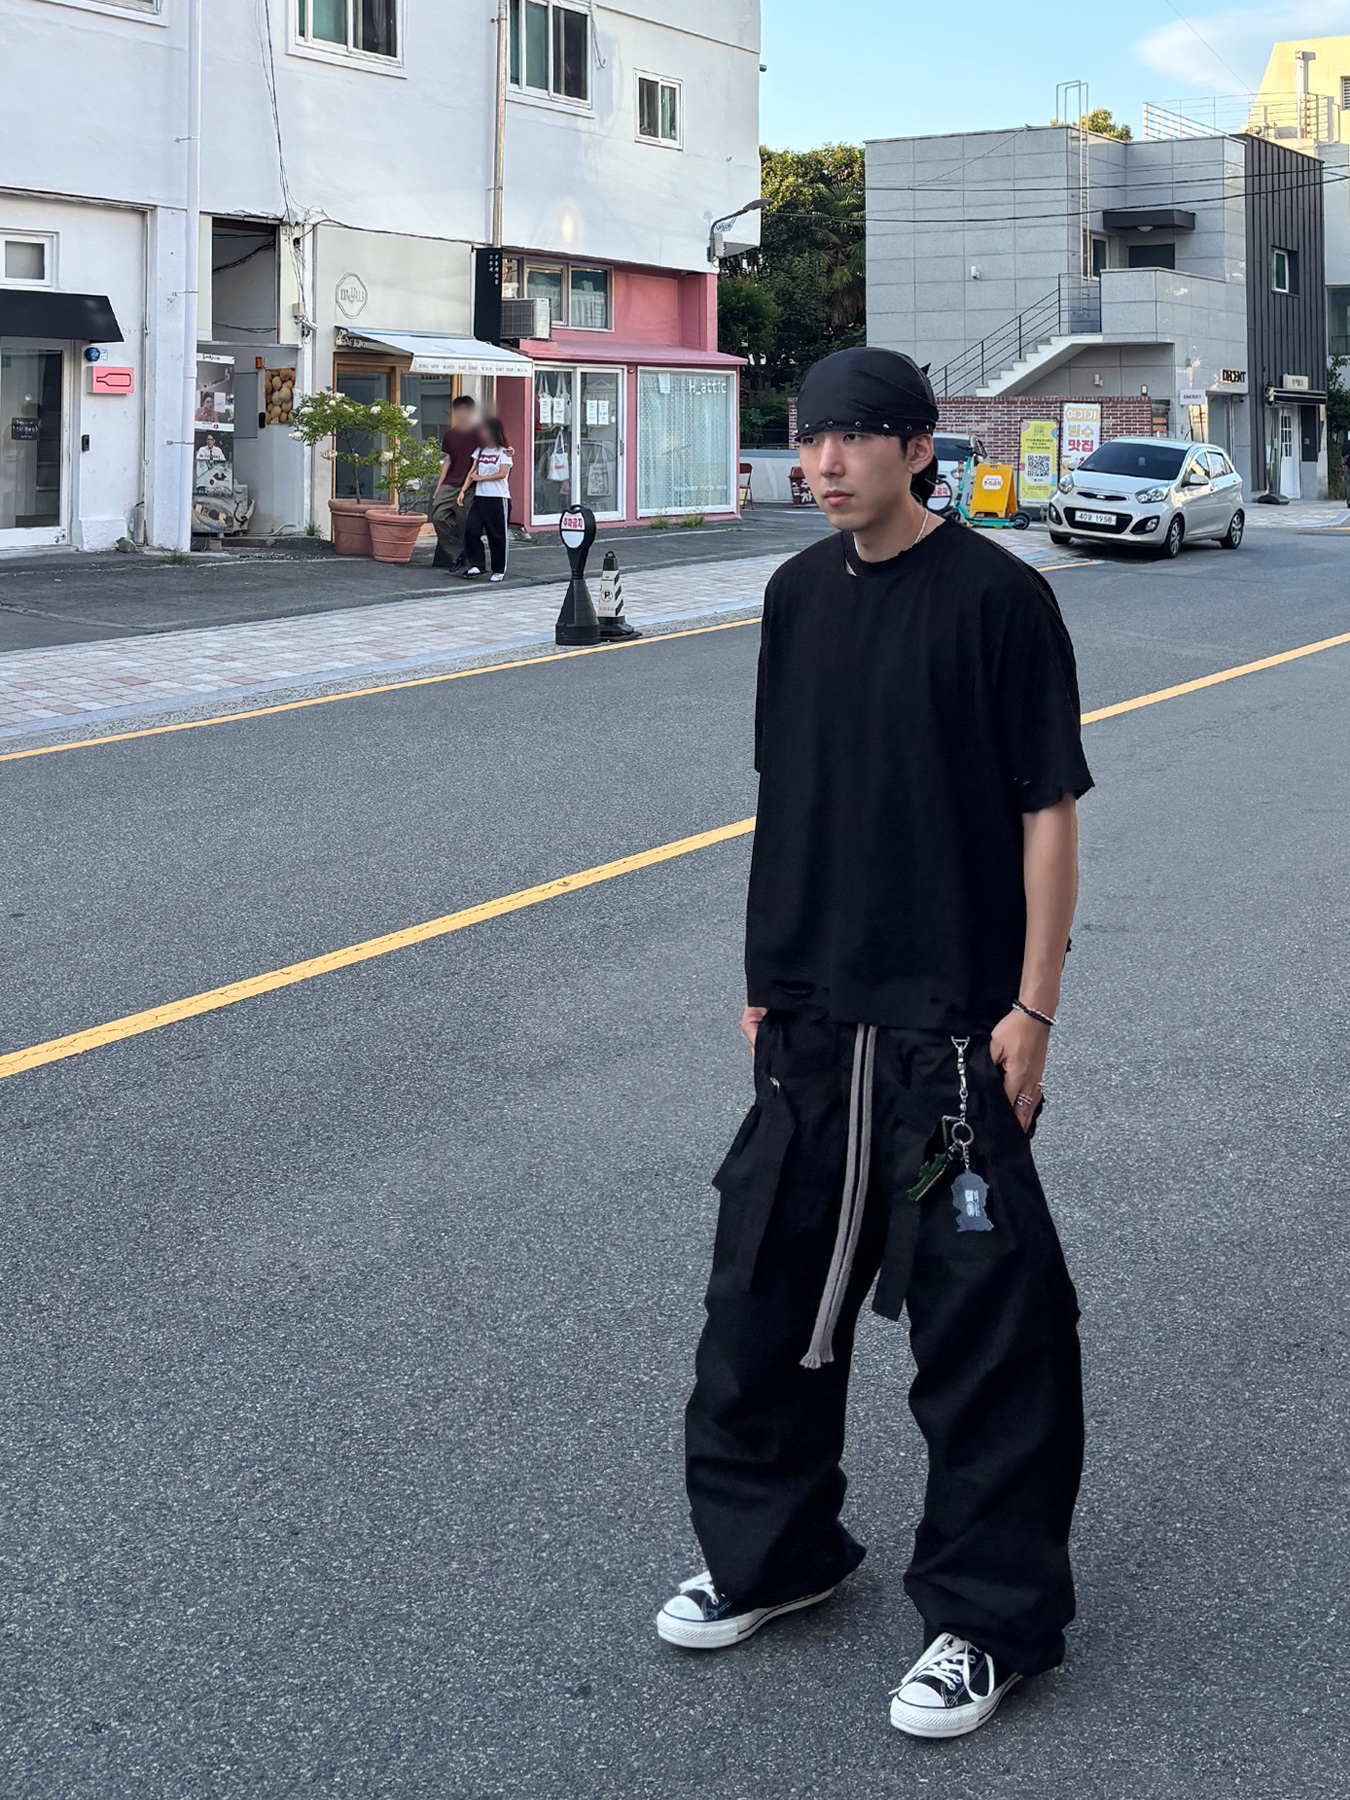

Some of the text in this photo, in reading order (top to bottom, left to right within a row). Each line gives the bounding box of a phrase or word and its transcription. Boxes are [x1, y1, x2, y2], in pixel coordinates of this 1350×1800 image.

[1066, 409, 1097, 420] 여기가
[1067, 439, 1094, 452] 맛집
[563, 517, 583, 528] 주차금지
